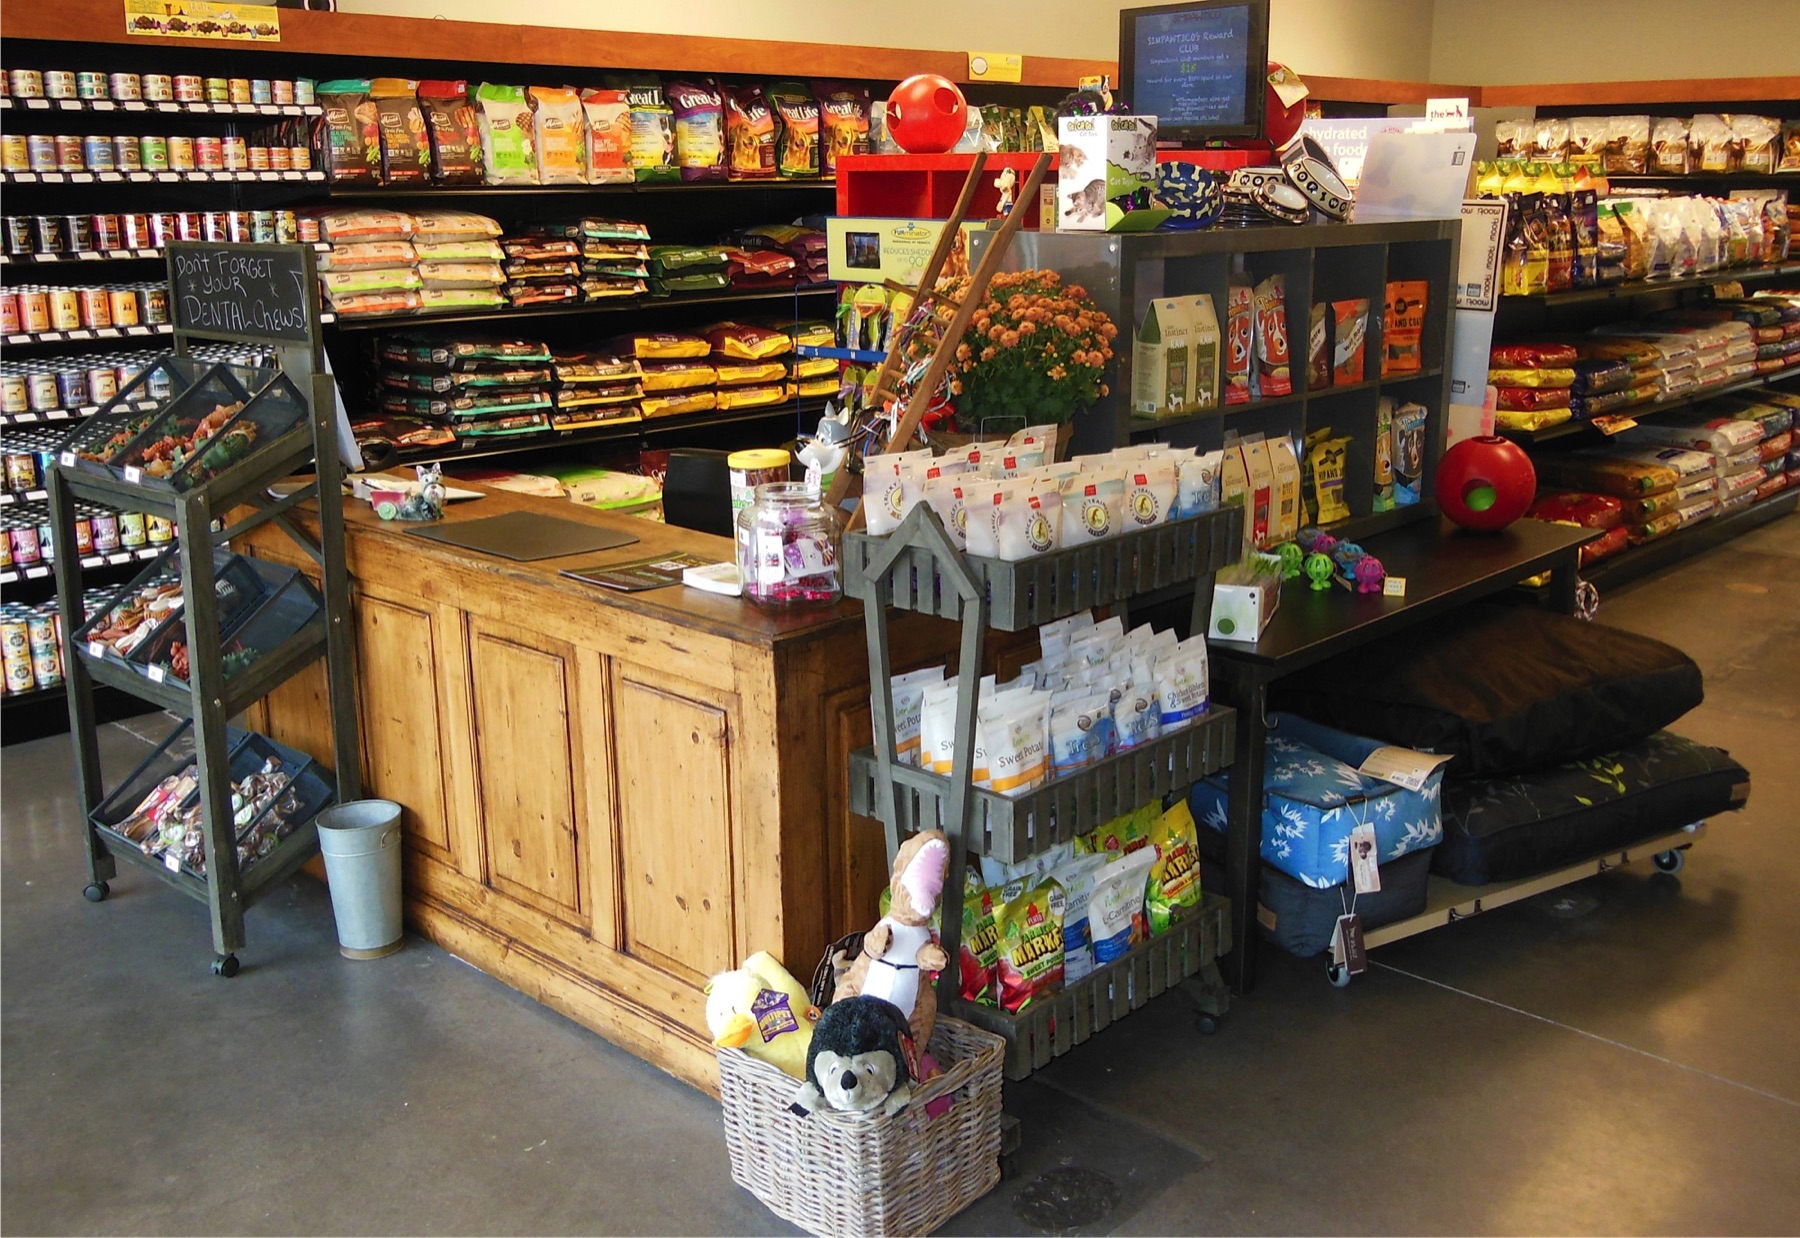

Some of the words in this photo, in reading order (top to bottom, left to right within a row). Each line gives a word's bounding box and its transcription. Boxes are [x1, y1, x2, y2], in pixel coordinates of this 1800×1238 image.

[1203, 28, 1234, 41] Reward
[1179, 45, 1199, 54] CLUB
[1430, 110, 1444, 118] the
[1297, 126, 1367, 143] hydrated
[1109, 177, 1120, 185] Cat
[1121, 176, 1134, 187] Toys
[883, 247, 909, 255] REDUCES
[910, 248, 933, 256] SHEDDI
[175, 252, 210, 279] Don't
[213, 250, 274, 279] FORGET
[202, 275, 247, 298] YOUR
[183, 295, 252, 332] DENTAL
[1395, 319, 1408, 328] AND
[1164, 327, 1188, 337] Instinct
[1170, 339, 1185, 349] RAW
[1170, 697, 1177, 709] &
[906, 714, 921, 729] Pota
[998, 751, 1024, 769] Sweet
[1023, 741, 1043, 760] Potat
[1002, 890, 1018, 899] FREE
[1003, 884, 1022, 893] GRAIN
[1050, 893, 1064, 902] GRAIN
[1065, 892, 1090, 912] Carniti
[1050, 901, 1065, 909] FREE
[1102, 895, 1141, 925] L-Carnitine
[976, 915, 995, 933] FARM
[1027, 914, 1044, 926] PLATO
[969, 924, 998, 956] MAR
[1011, 927, 1064, 967] MARKE
[1025, 961, 1046, 977] SWEET
